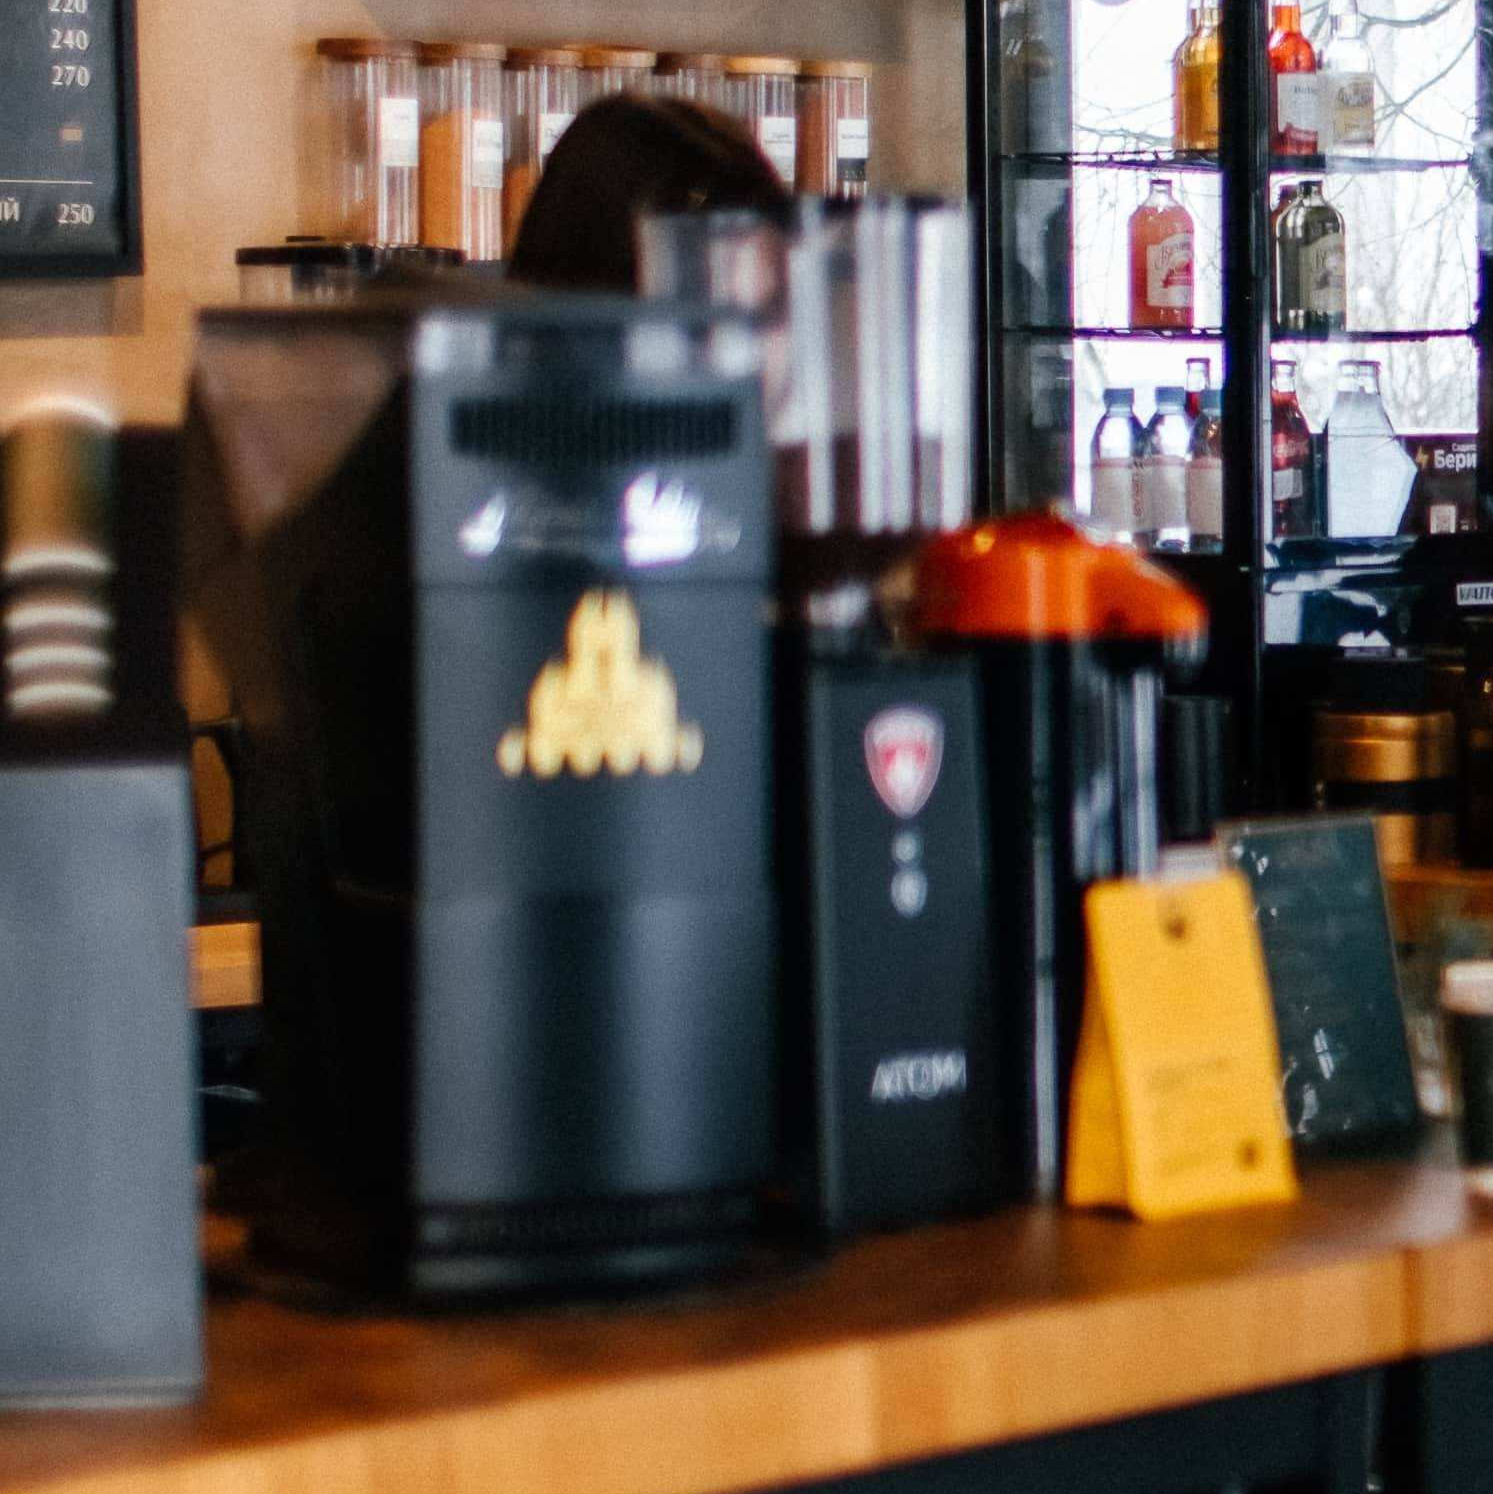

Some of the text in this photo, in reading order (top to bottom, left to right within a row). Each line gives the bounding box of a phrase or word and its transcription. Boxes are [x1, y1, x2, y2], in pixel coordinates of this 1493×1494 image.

[50, 28, 89, 50] 240
[51, 65, 90, 87] 270
[57, 203, 95, 225] 250
[1433, 449, 1477, 472] Бери
